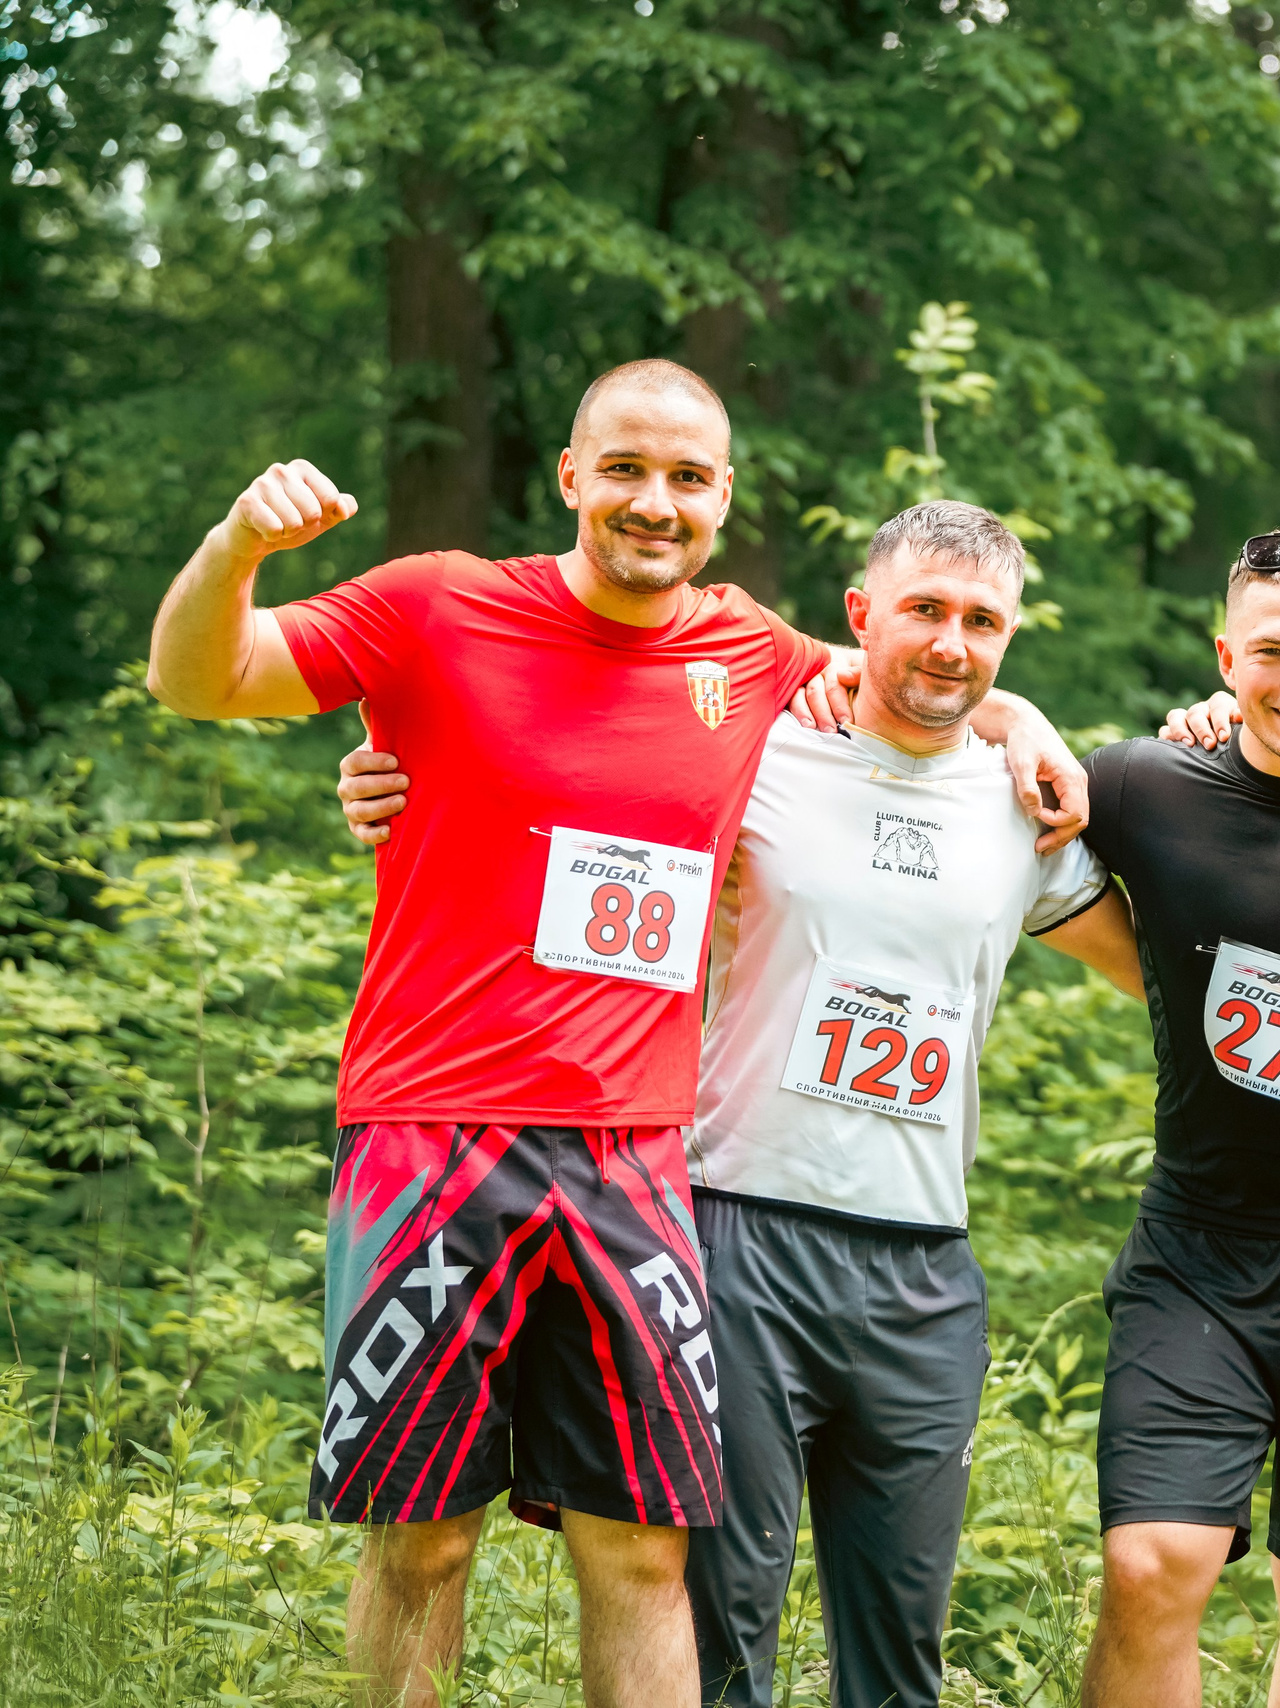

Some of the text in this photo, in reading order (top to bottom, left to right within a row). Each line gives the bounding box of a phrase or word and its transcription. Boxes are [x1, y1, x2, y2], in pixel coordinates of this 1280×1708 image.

[873, 820, 882, 841] CLUB
[876, 811, 904, 824] LLUITA
[570, 859, 651, 885] BOGAL
[872, 859, 938, 881] LA MINA
[585, 882, 675, 963] 88
[624, 963, 666, 977] МАРАФОН
[668, 970, 685, 980] 2026
[824, 996, 909, 1028] BOGAL
[816, 1018, 950, 1105] 129
[796, 1082, 869, 1107] СПОРТИВНЫЙ
[924, 1112, 941, 1121] 2026
[630, 1251, 723, 1477] RD
